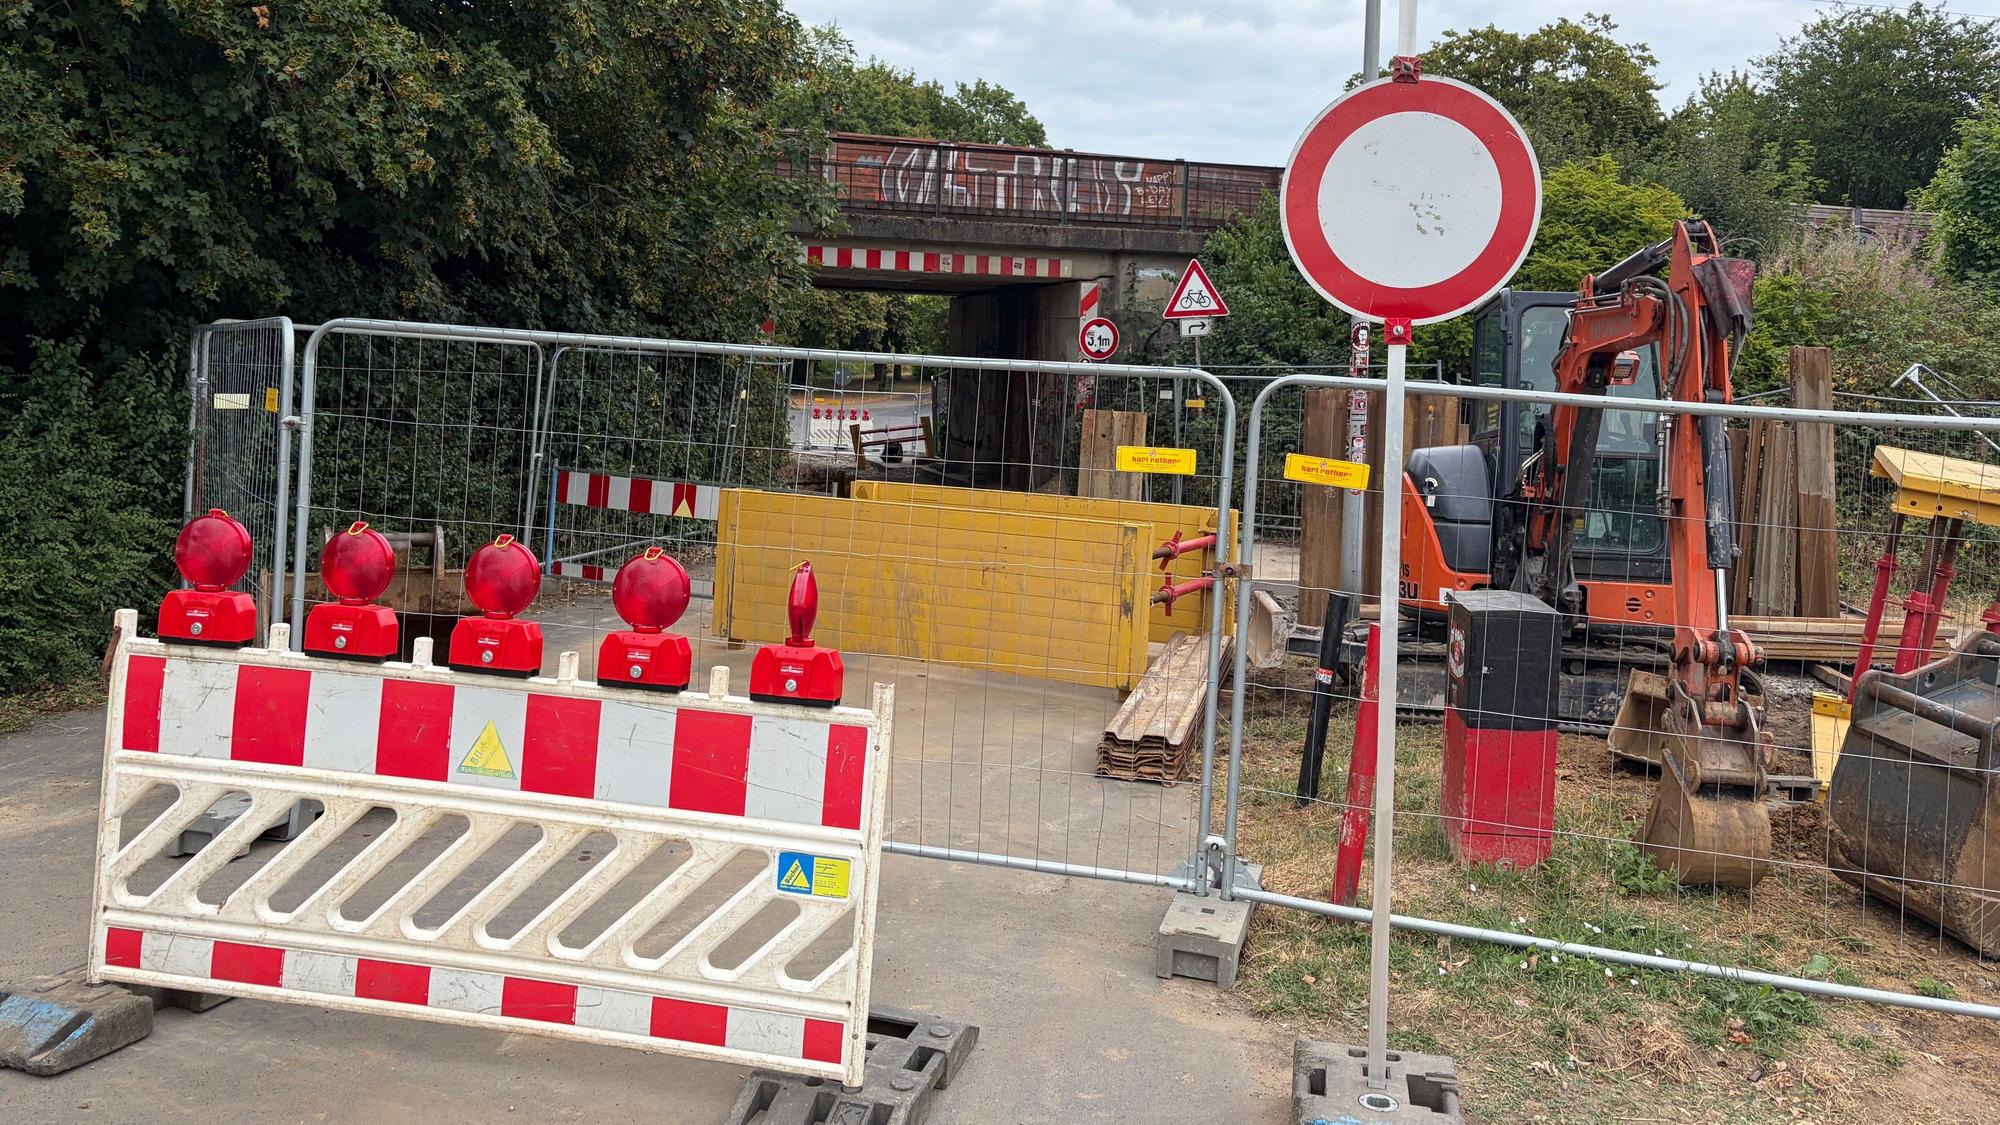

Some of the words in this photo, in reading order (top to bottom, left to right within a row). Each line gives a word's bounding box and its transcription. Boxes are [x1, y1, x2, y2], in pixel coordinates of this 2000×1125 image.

[1150, 457, 1177, 465] rother
[1301, 465, 1319, 473] karl
[1320, 468, 1348, 477] rother
